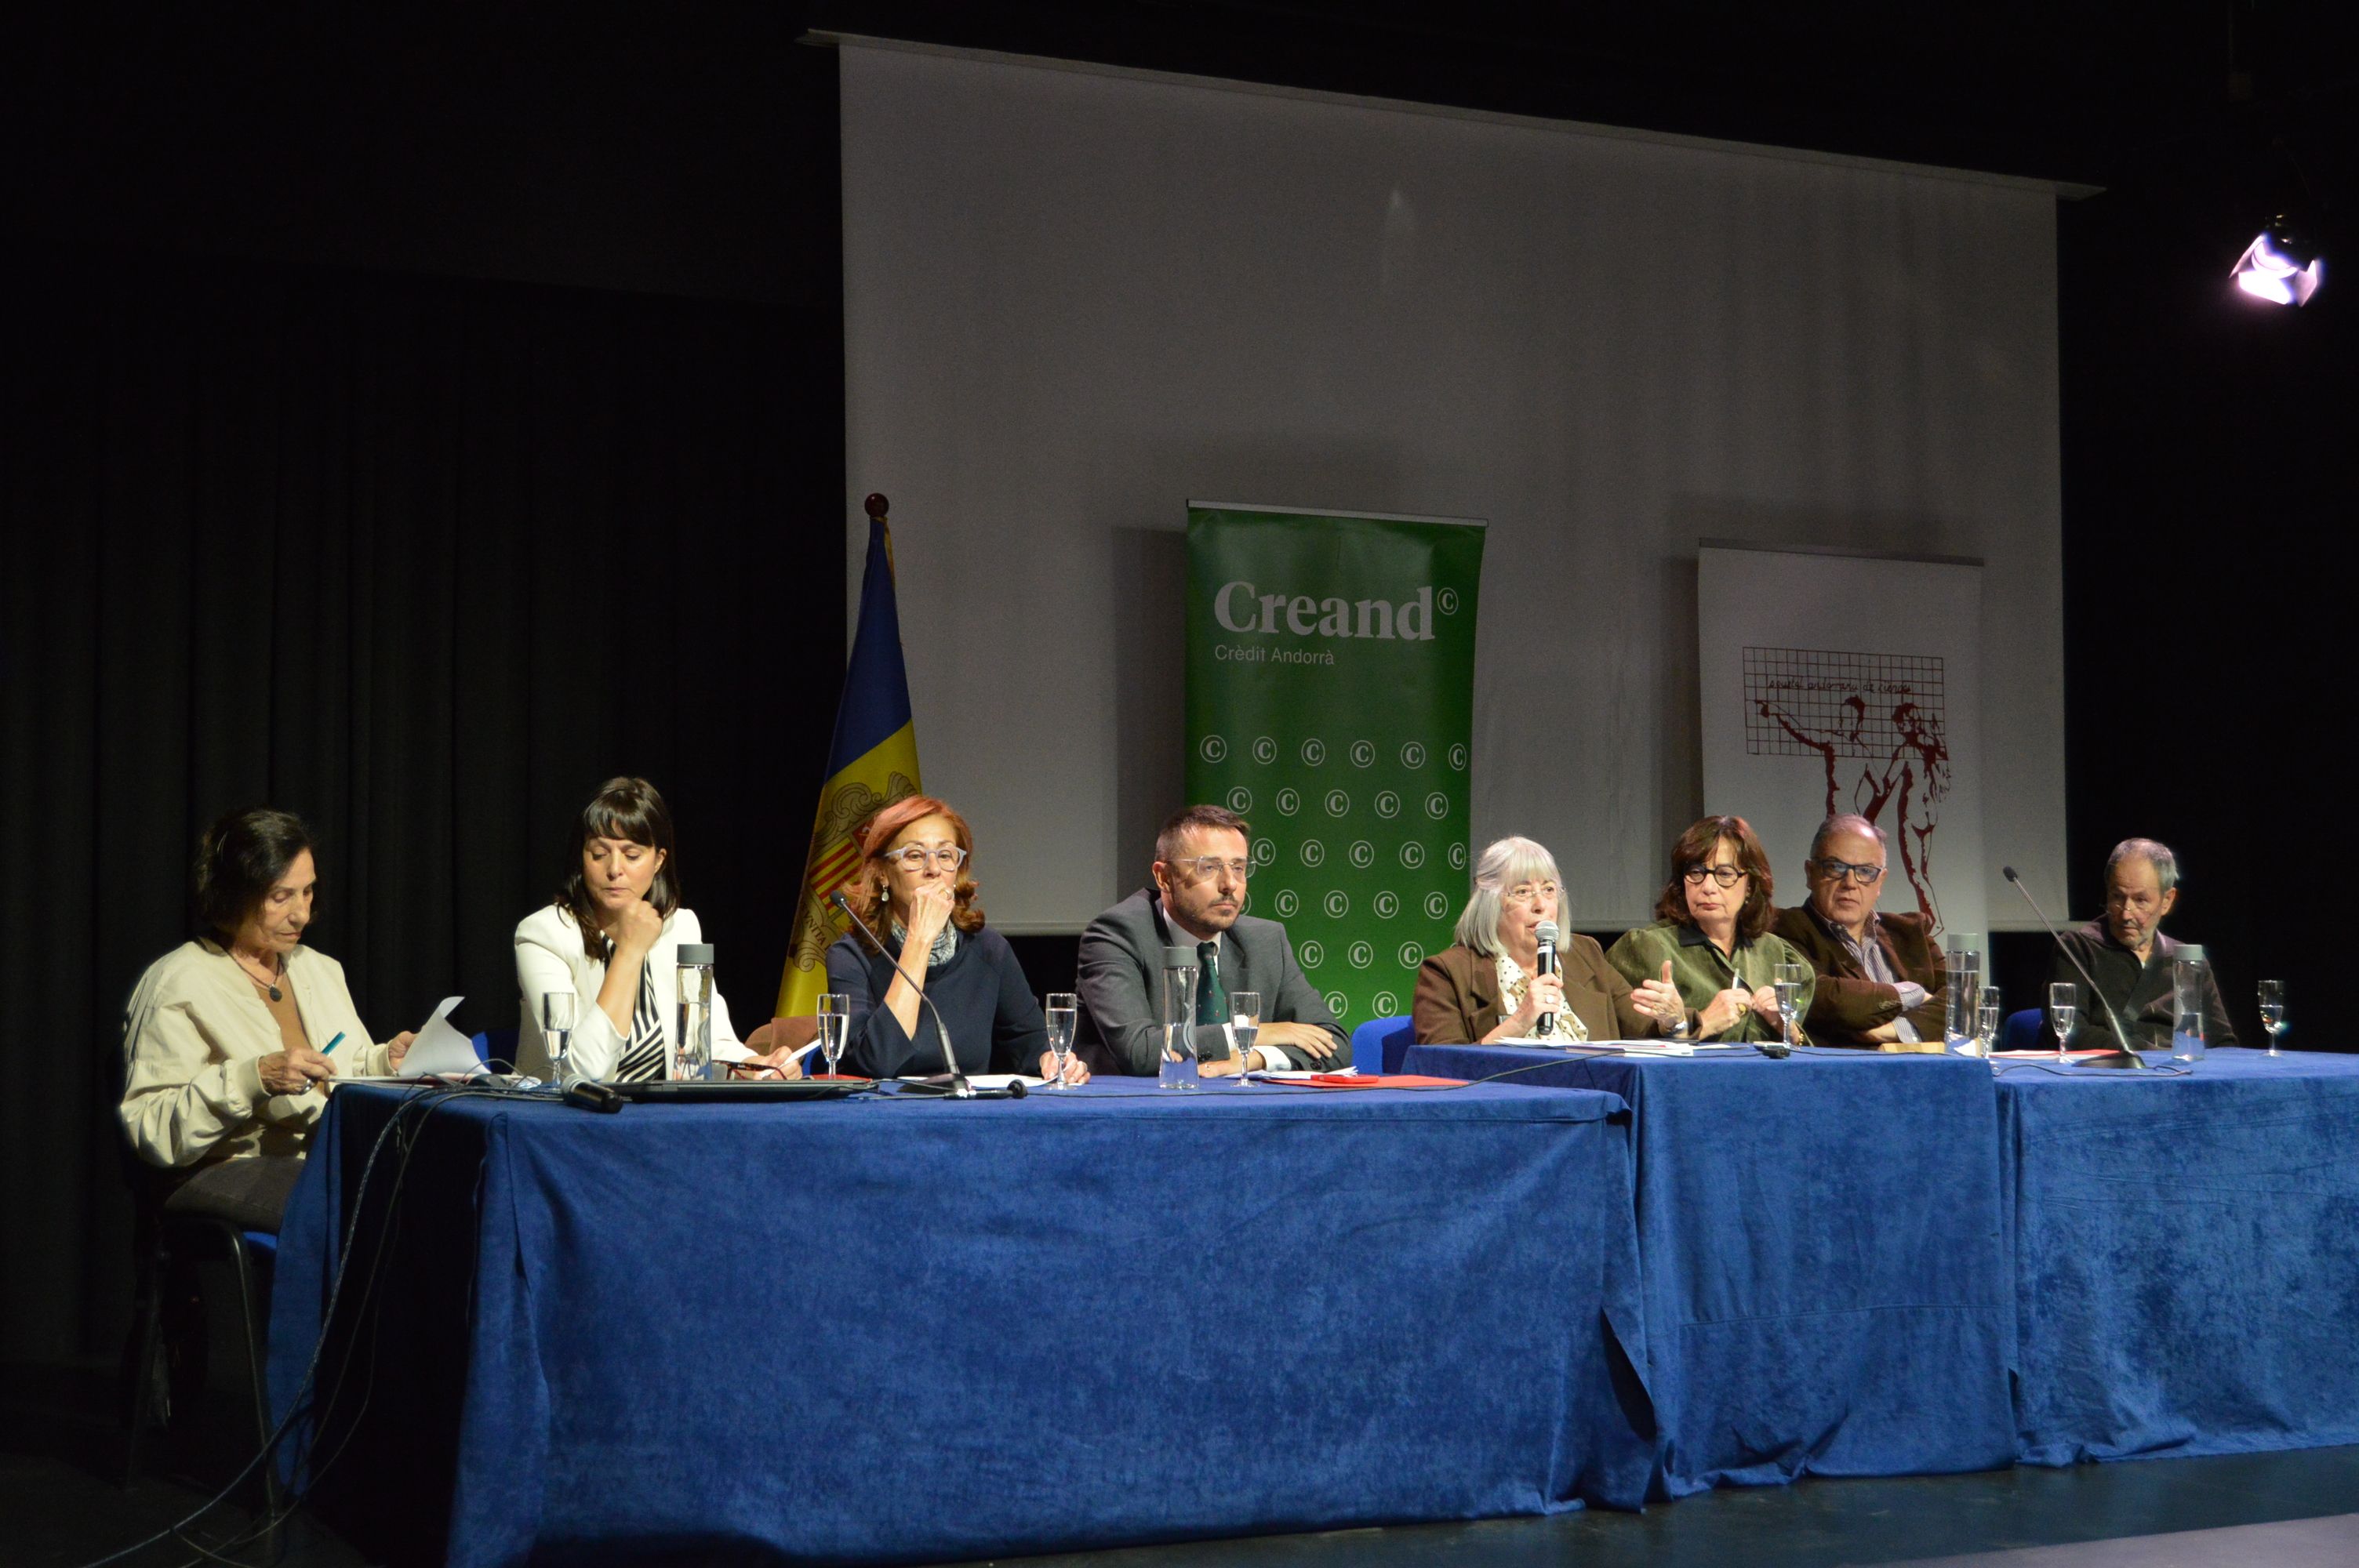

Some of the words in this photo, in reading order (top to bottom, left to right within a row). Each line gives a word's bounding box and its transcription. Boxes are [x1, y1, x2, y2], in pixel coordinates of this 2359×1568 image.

[1214, 581, 1435, 641] Creand
[1214, 644, 1266, 662] Crèdit
[1271, 648, 1335, 666] Andorrà
